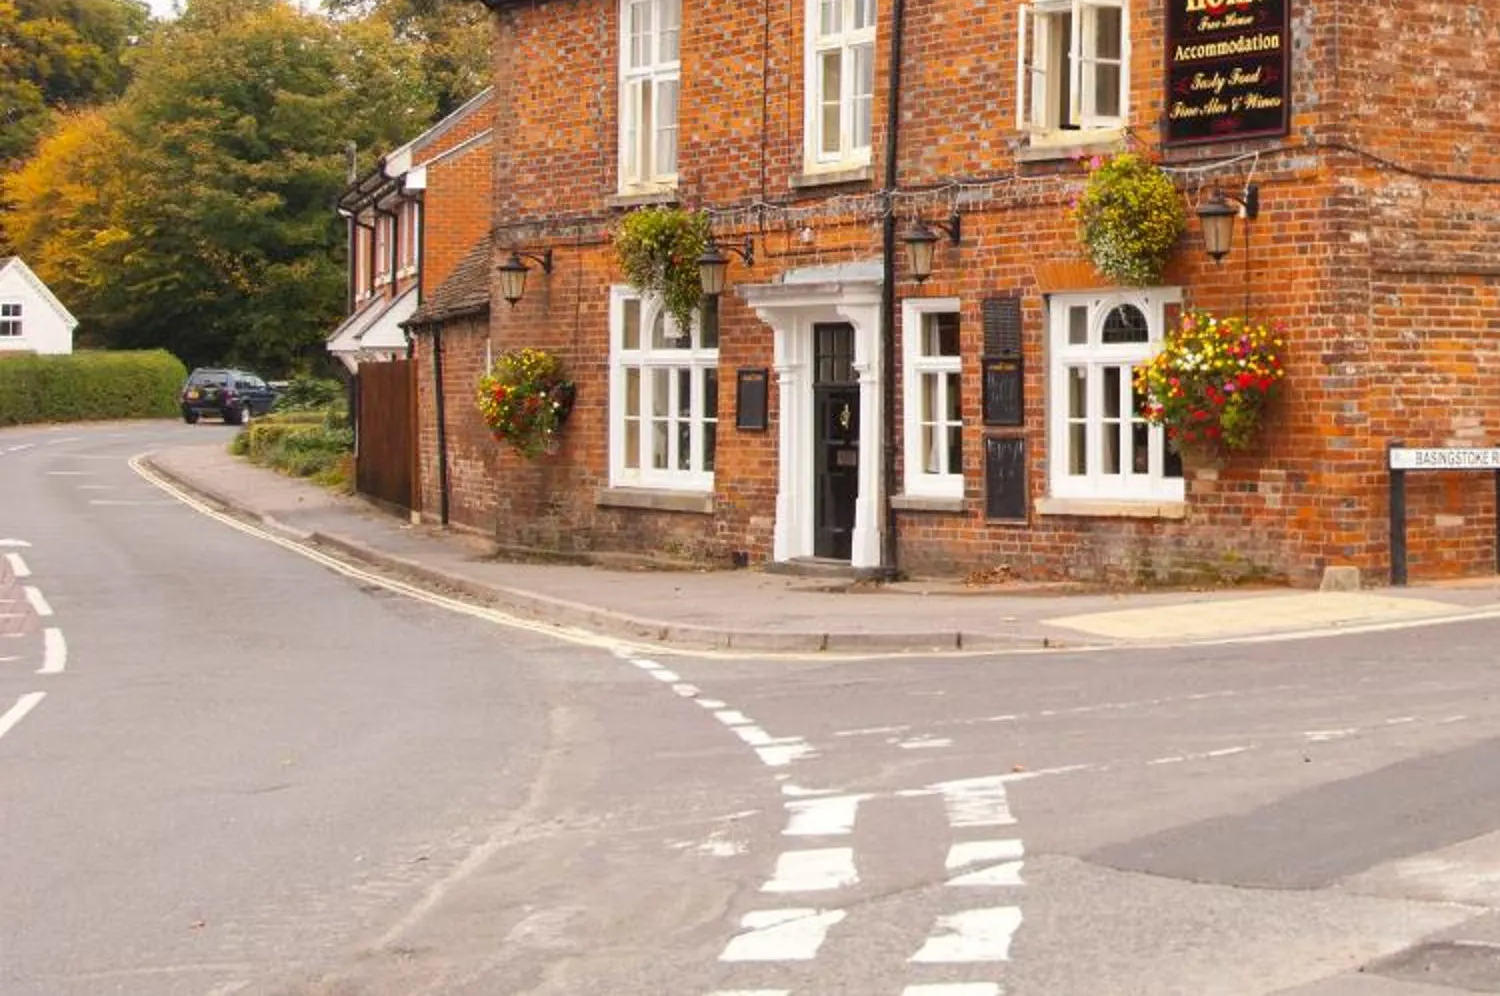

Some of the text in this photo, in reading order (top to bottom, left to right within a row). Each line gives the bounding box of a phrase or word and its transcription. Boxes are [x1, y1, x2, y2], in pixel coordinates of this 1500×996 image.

[1197, 12, 1255, 32] Free House
[1174, 33, 1280, 61] Accommodation
[1190, 66, 1262, 94] Tasty Food
[1169, 101, 1203, 119] Fine
[1243, 92, 1281, 110] Wines
[1415, 451, 1489, 465] BASINGSTOKE
